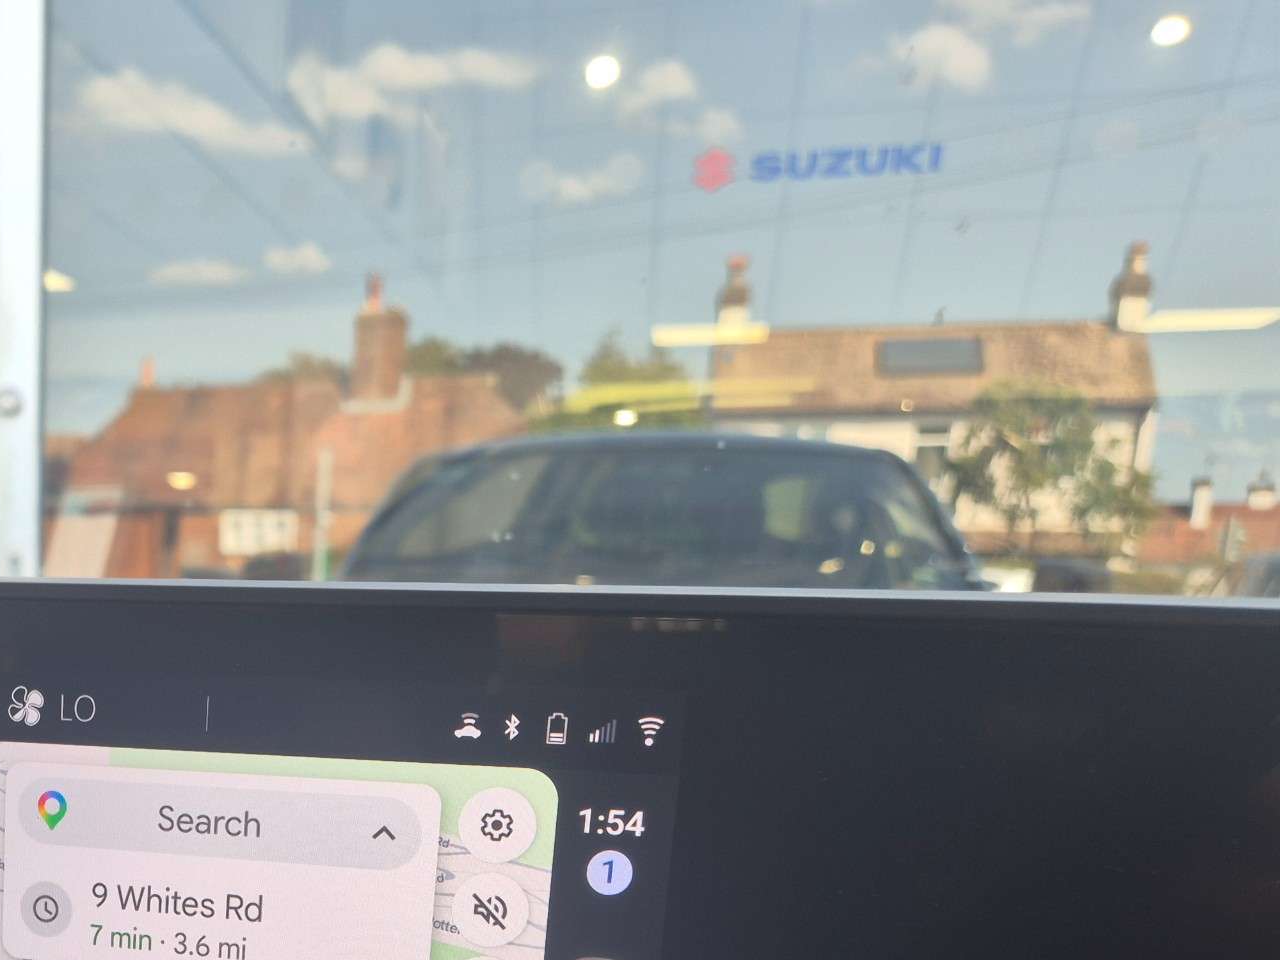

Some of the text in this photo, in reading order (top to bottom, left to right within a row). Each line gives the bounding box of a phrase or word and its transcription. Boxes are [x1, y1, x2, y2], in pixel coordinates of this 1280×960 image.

[751, 142, 944, 182] SUZUKI
[61, 694, 97, 722] LO
[157, 805, 262, 838] Search
[579, 808, 645, 837] 1:54
[602, 860, 614, 884] 1
[91, 882, 263, 923] 9 Whites Rd
[90, 923, 247, 960] 7 min 3.6 mi
